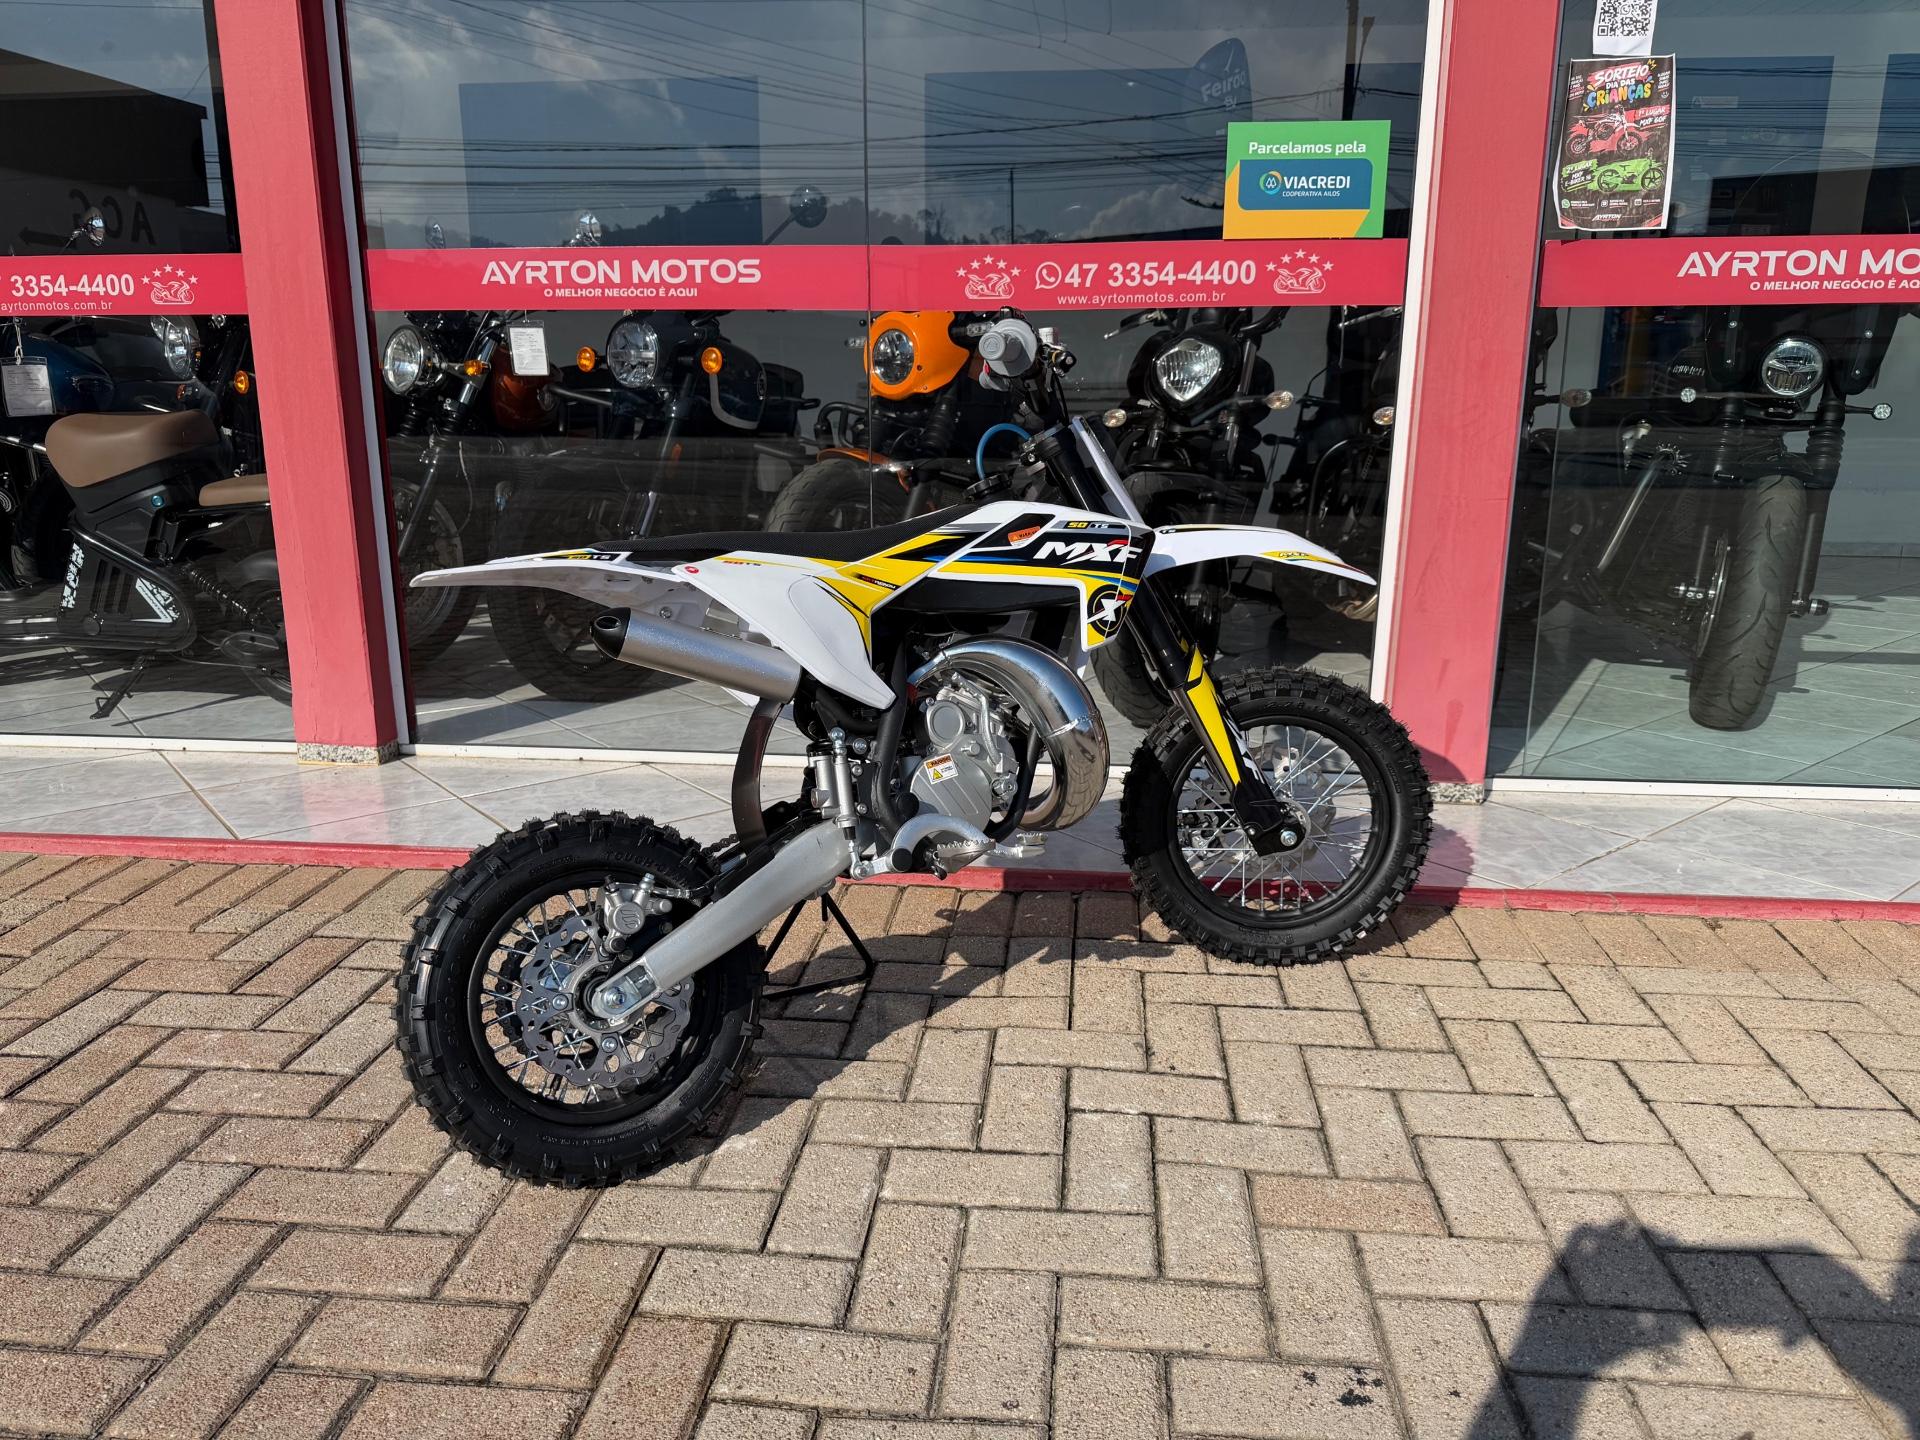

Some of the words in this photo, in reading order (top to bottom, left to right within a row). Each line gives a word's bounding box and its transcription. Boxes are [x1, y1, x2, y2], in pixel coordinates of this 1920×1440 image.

[1594, 65, 1650, 88] SORTEIO
[1606, 81, 1619, 89] DIA
[1620, 78, 1636, 87] DAS
[1248, 142, 1332, 154] Parcelamos
[1335, 141, 1366, 156] pela
[1283, 175, 1350, 189] VIACREDI
[481, 259, 621, 285] AYRTON
[632, 258, 762, 284] MOTOS
[1676, 249, 1848, 278] AYRTON
[1064, 263, 1098, 289] 47
[1108, 259, 1256, 287] 3354-4400
[10, 273, 135, 297] 3354-4400
[544, 288, 553, 297] O
[555, 288, 602, 297] MELHOR
[604, 286, 656, 297] NEGÓCIO
[658, 285, 666, 297] É
[668, 287, 698, 297] AQUI
[1749, 281, 1761, 291] O
[1763, 280, 1819, 291] MELHOR
[1823, 277, 1885, 290] NEGÓCIO
[1887, 277, 1896, 290] É
[1057, 290, 1227, 306] www.ayrtonmotos.com.br
[1033, 540, 1144, 565] MXF
